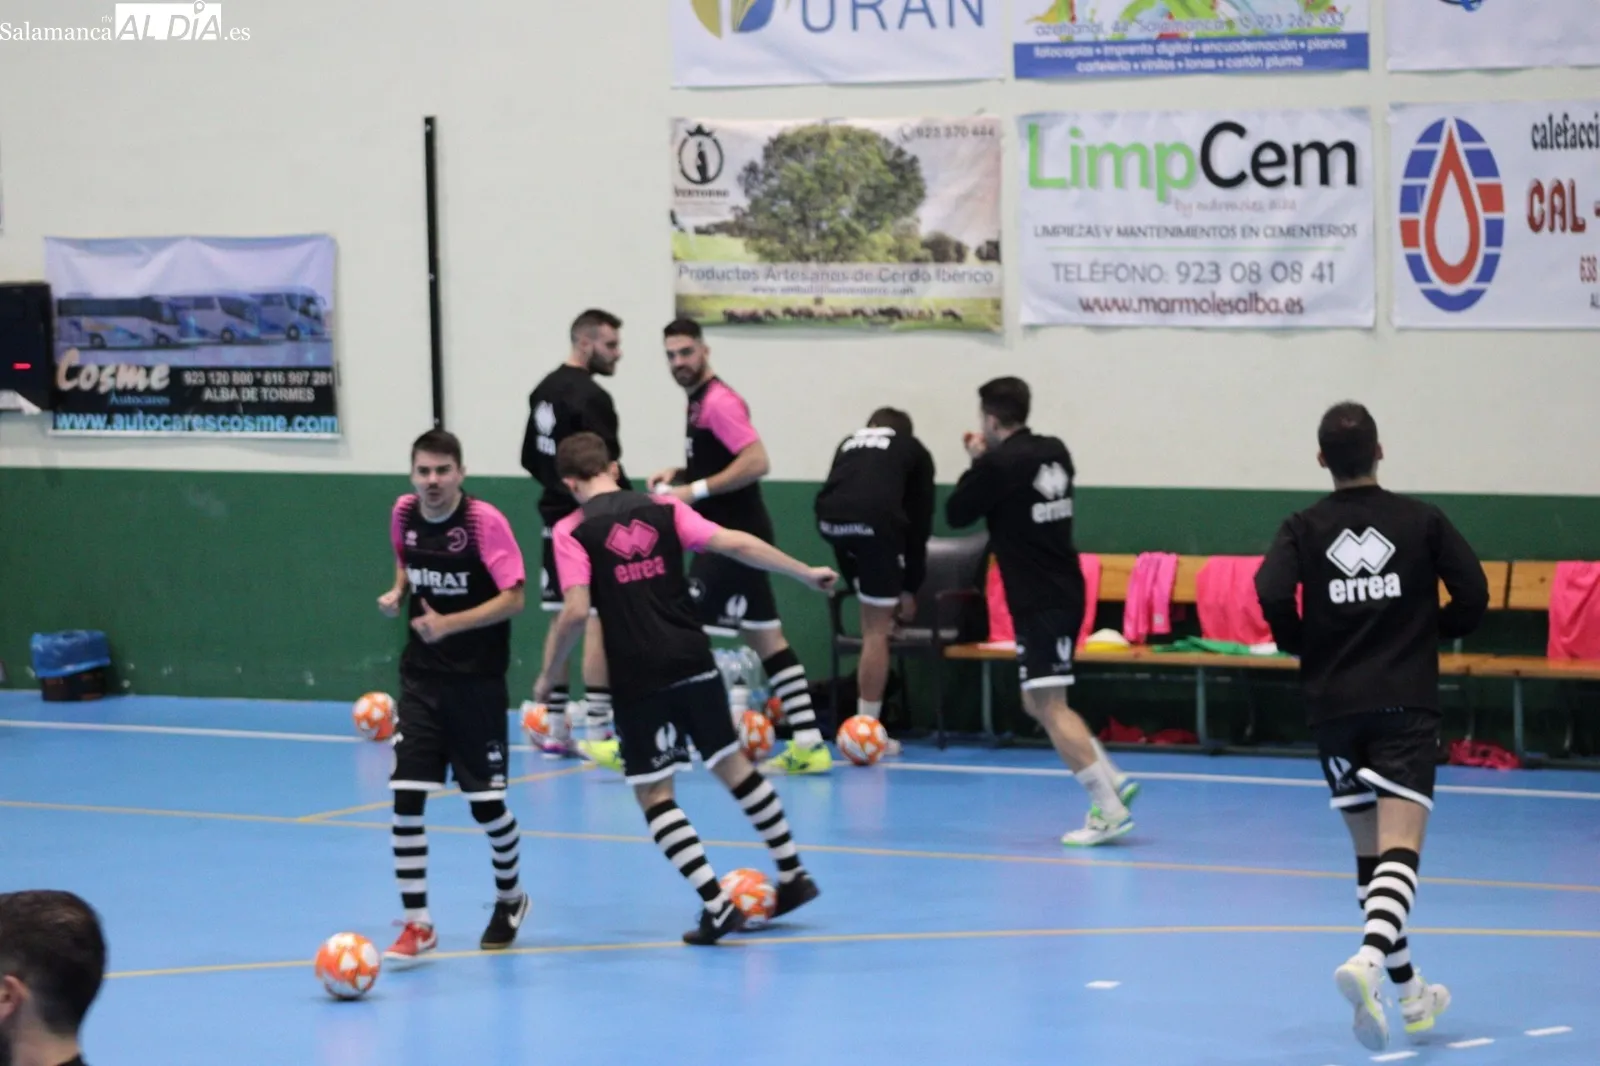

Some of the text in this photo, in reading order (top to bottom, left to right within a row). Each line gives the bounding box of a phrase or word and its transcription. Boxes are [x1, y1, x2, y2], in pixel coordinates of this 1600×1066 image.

[1103, 42, 1154, 58] imprenta
[1156, 41, 1193, 57] digital
[1306, 37, 1348, 52] planos
[1264, 55, 1304, 70] pluma
[1028, 121, 1358, 203] LimpCem
[1527, 178, 1587, 233] CAL
[1033, 223, 1358, 239] LIMPIEZAS Y MANTENIMIENTOS EN CEMENTERIOS
[678, 264, 759, 282] Productos
[853, 267, 873, 282] de
[1051, 258, 1335, 285] TELÉFONO: 923 08 08 41
[1080, 290, 1304, 315] www.marmolesalba.es
[57, 347, 170, 394] Cosme
[183, 370, 206, 386] 923
[203, 387, 315, 402] ALBA DE TORMES
[56, 409, 339, 432] www.autocarescosme.com
